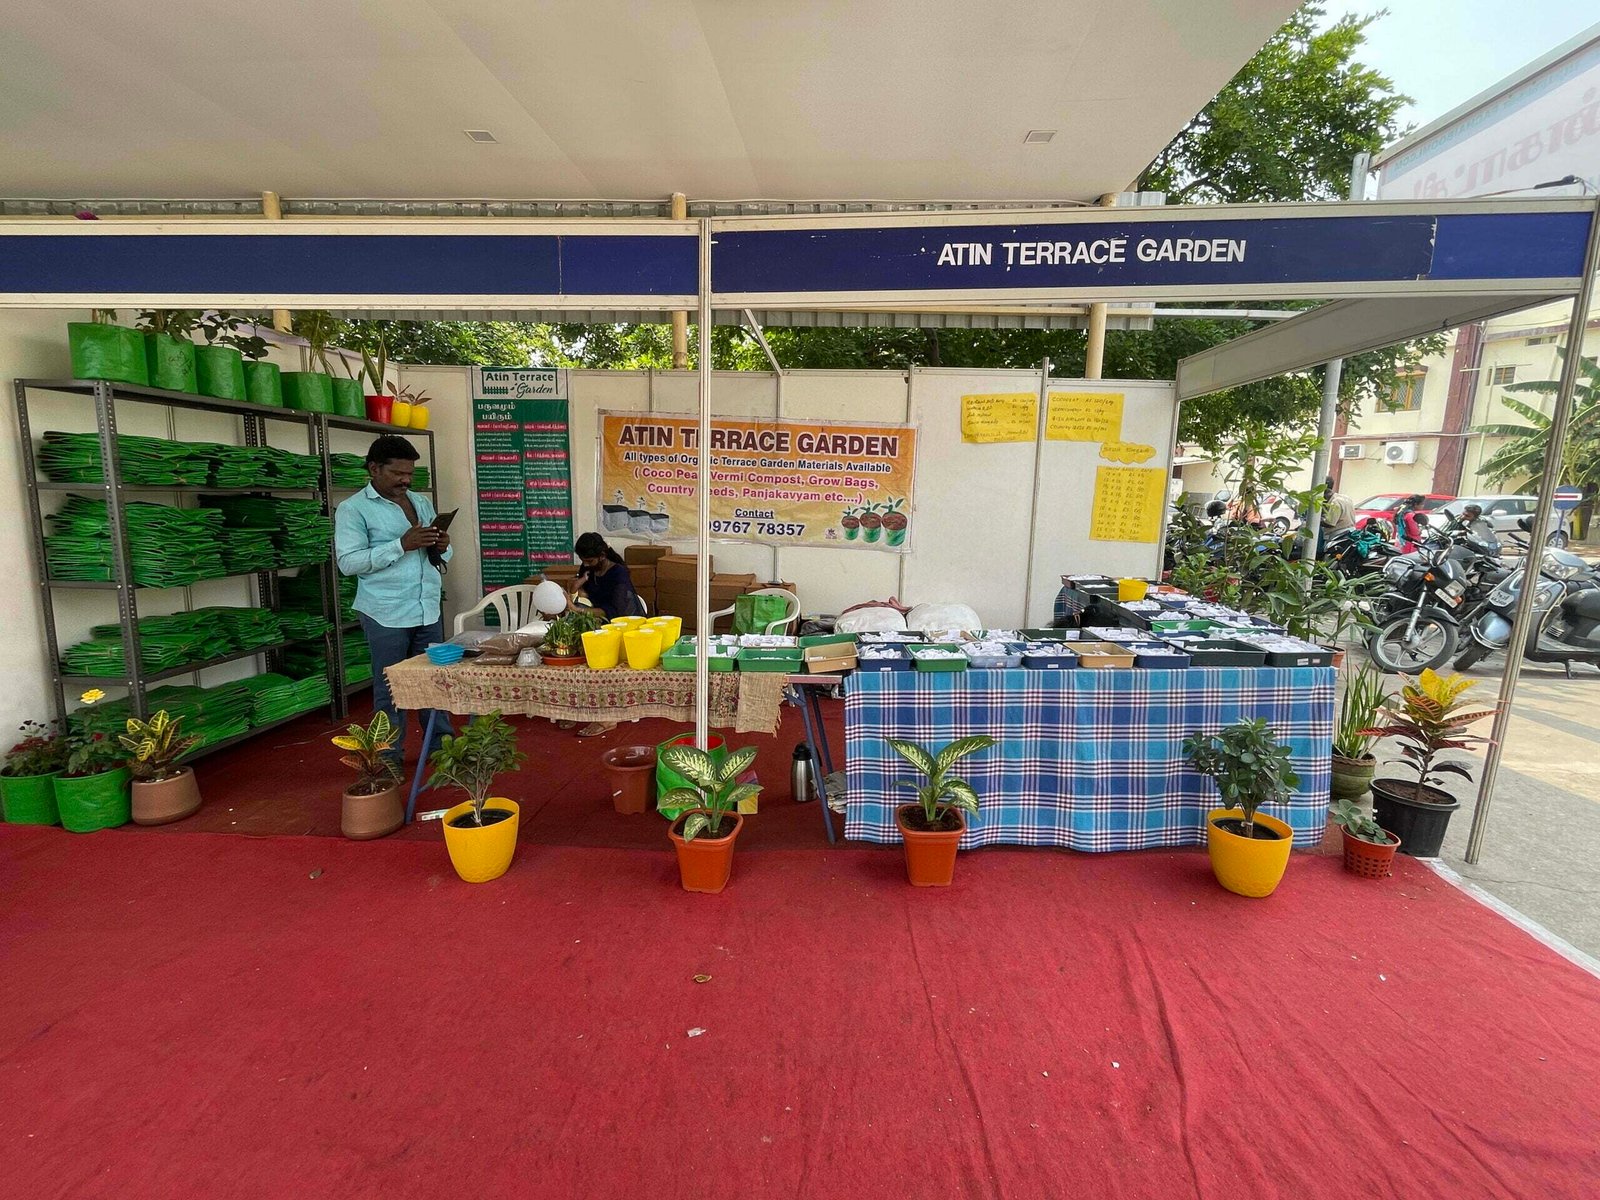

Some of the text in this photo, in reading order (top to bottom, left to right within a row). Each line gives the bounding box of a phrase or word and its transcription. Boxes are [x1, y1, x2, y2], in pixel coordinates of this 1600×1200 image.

[937, 239, 1246, 266] ATIN TERRACE GARDEN
[485, 373, 554, 381] Atin Terrace
[516, 382, 553, 398] Garden
[619, 425, 673, 446] ATIN
[797, 433, 898, 456] GARDEN
[624, 452, 891, 472] All types of Orgic Terrace Garden Materials Available
[642, 468, 672, 478] Coco
[711, 471, 743, 482] Vermi
[748, 473, 804, 485] Compost,
[809, 476, 840, 486] Grow
[845, 477, 878, 489] Bags,
[648, 484, 694, 497] Country
[709, 488, 738, 498] eeds,
[743, 488, 820, 502] Panjakavyam
[735, 508, 774, 519] Contact
[709, 520, 805, 536] 9767 78357
